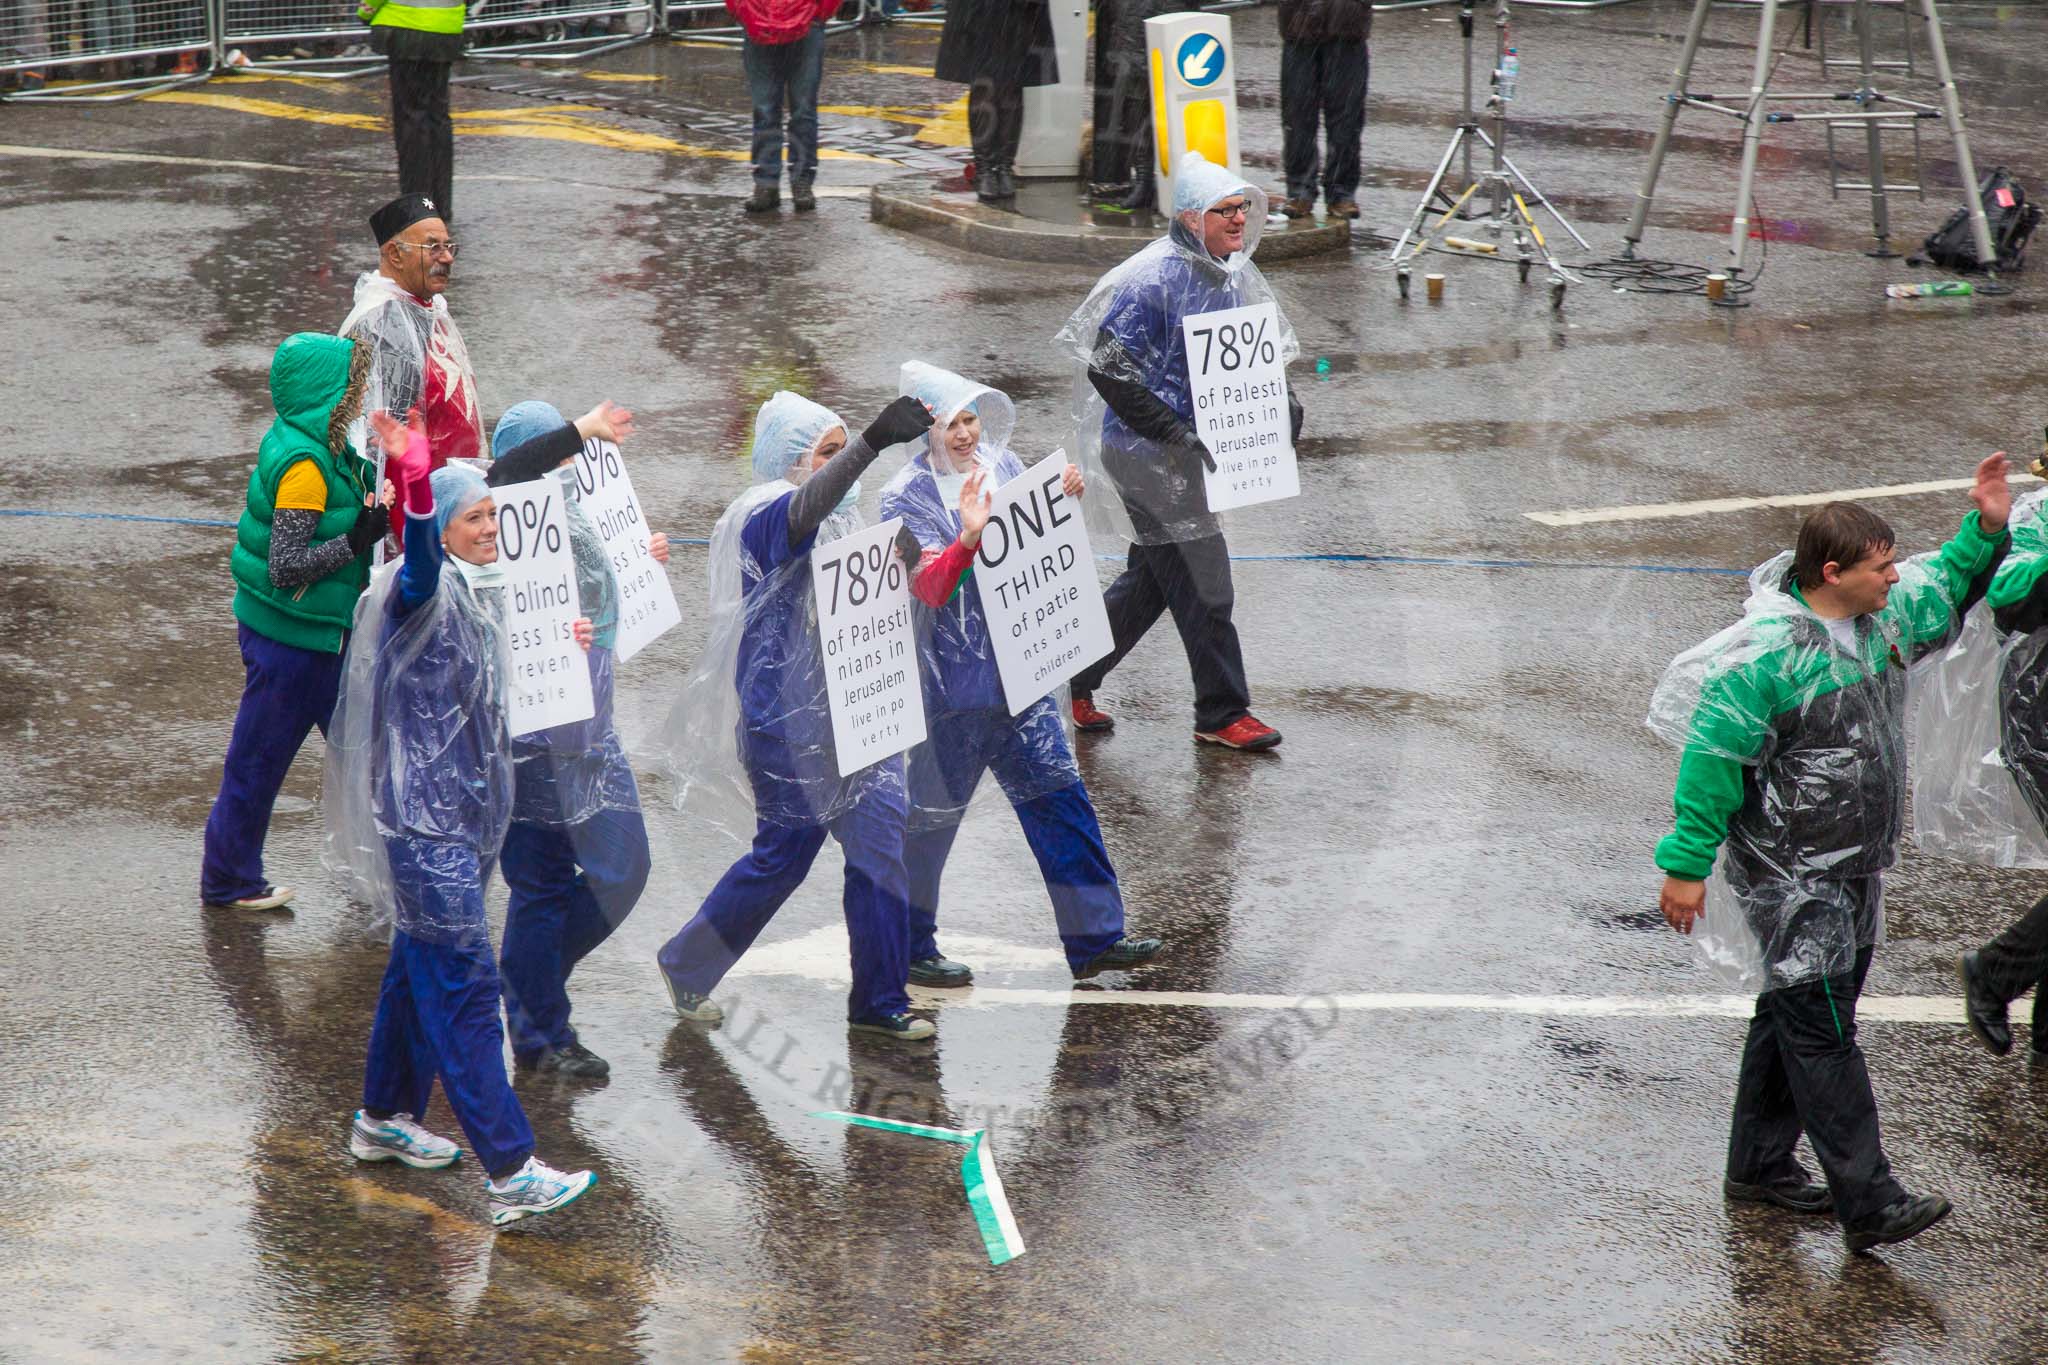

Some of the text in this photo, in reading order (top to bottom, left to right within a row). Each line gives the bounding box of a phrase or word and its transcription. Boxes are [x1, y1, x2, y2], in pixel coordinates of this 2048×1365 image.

[1192, 317, 1275, 376] 78%
[1198, 377, 1284, 409] of Palesti
[1209, 406, 1279, 432] nians in
[1215, 430, 1280, 454] Jerusalem
[576, 438, 619, 503] 0%
[1222, 456, 1278, 475] live in po
[1232, 475, 1273, 491] verty
[496, 495, 560, 562] 0%
[596, 495, 638, 541] blind
[979, 473, 1072, 569] ONE
[613, 537, 648, 573] ss is
[513, 573, 570, 614] blind
[623, 569, 655, 599] even
[821, 535, 901, 617] 78%
[994, 543, 1076, 610] THIRD
[623, 600, 657, 630] table
[827, 604, 909, 658] of Palesti
[1012, 584, 1080, 639] of patie
[511, 618, 571, 650] ess is
[1023, 619, 1081, 662] nts are
[518, 655, 571, 679] reven
[837, 639, 905, 681] nians in
[1034, 643, 1082, 682] children
[518, 687, 565, 709] table
[844, 667, 906, 708] Jerusalem
[850, 698, 904, 730] live in po
[861, 723, 901, 748] verty
